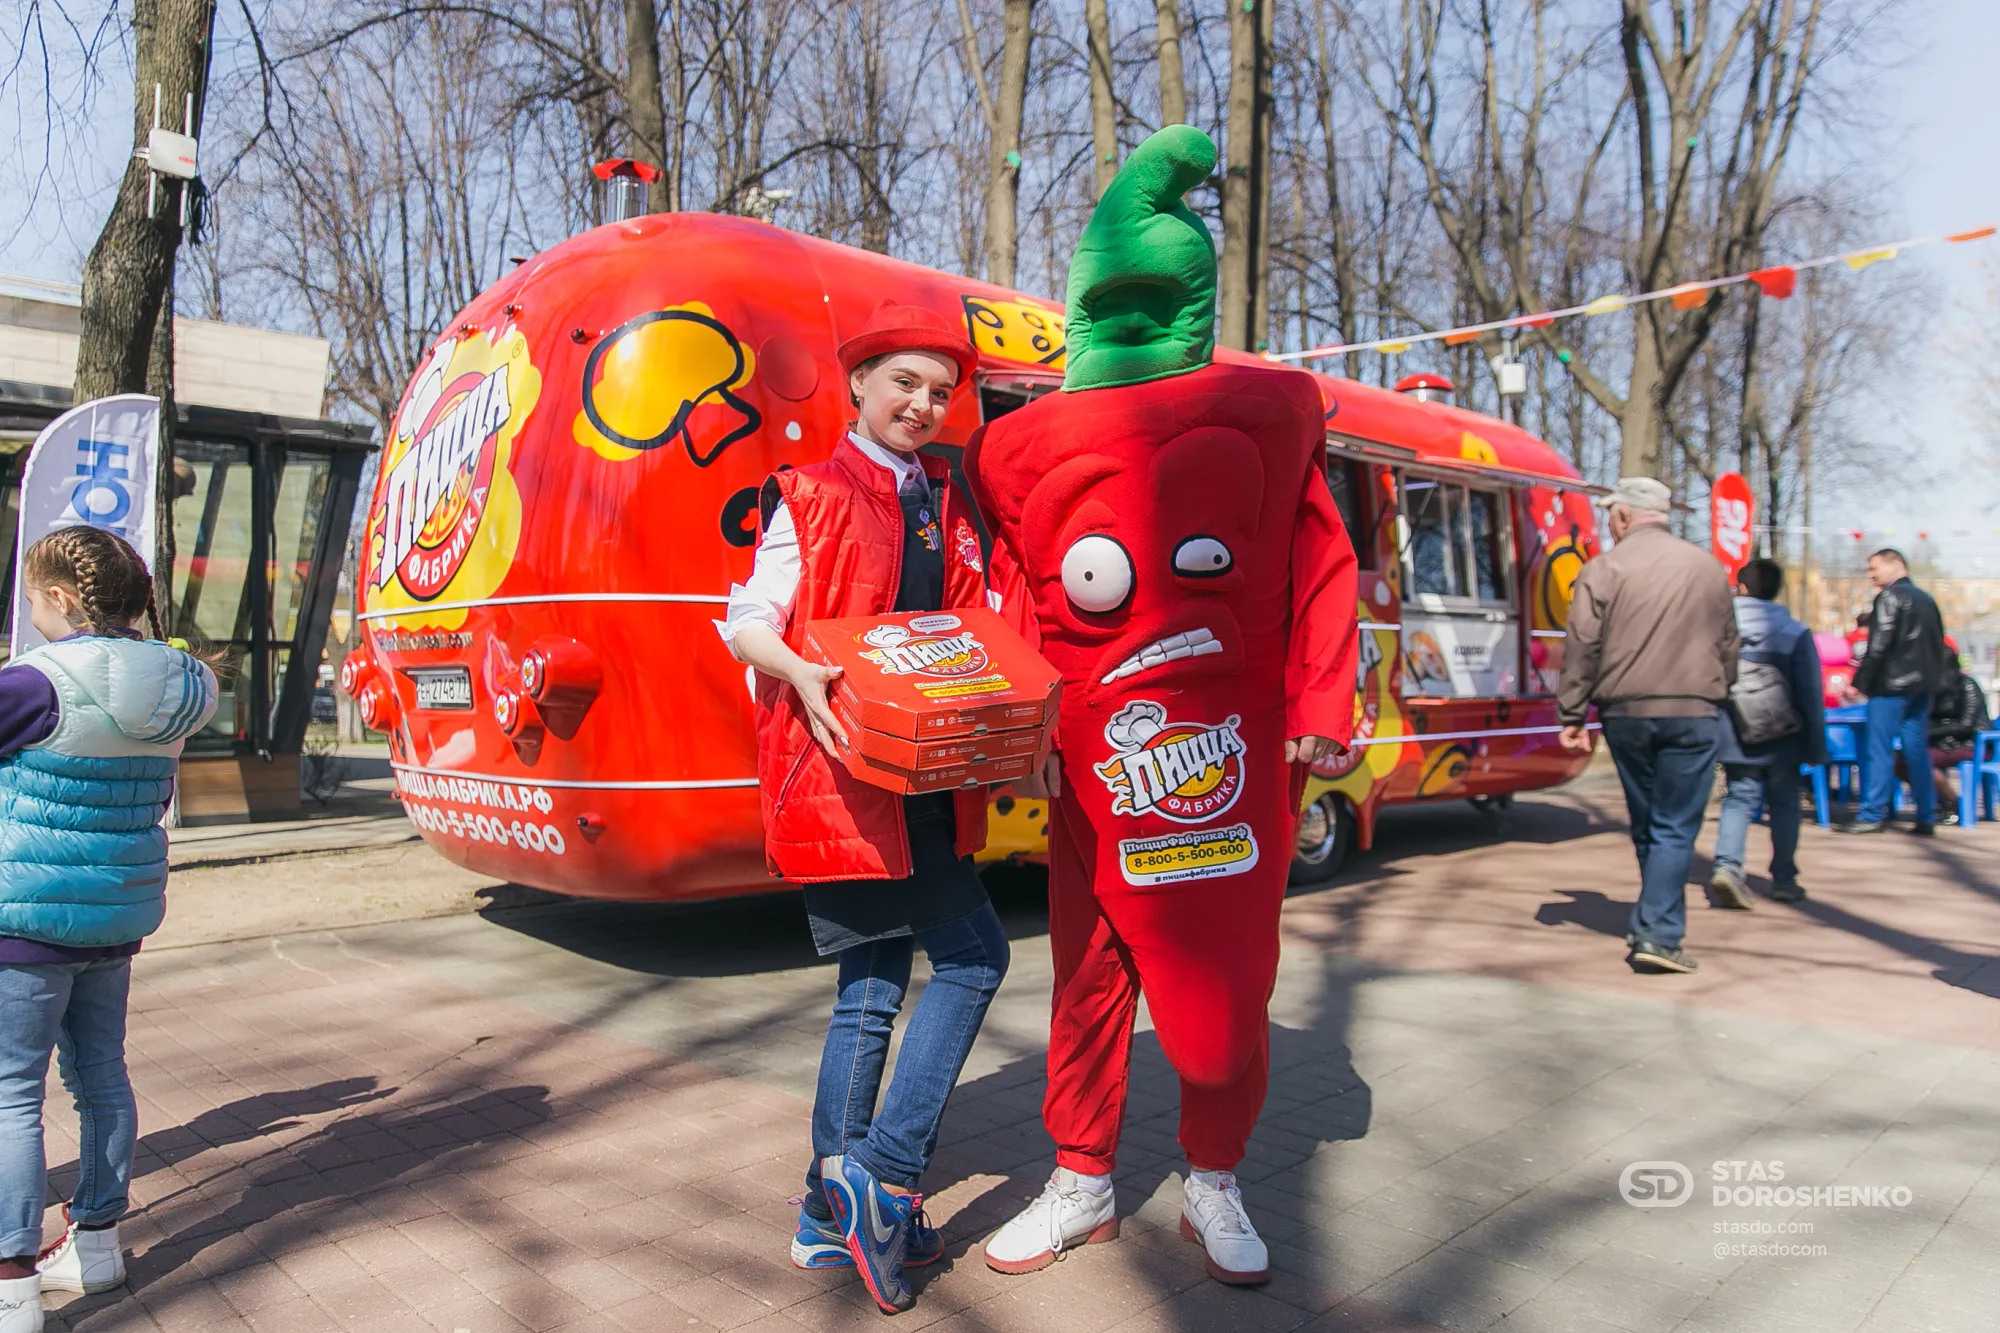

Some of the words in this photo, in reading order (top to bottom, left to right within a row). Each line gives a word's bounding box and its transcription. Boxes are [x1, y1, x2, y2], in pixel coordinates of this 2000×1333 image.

[379, 363, 511, 592] ПИЦЦА
[408, 485, 487, 587] ФАБРИКА
[882, 637, 981, 673] ПИЦЦА
[928, 655, 982, 674] ФАБРИКА
[1122, 726, 1243, 812] ПИЦЦА
[1167, 775, 1237, 813] ФАБРИКА
[1125, 826, 1248, 853] ПиццаФабрика.рф
[1134, 843, 1245, 868] 8-800-5-500-600
